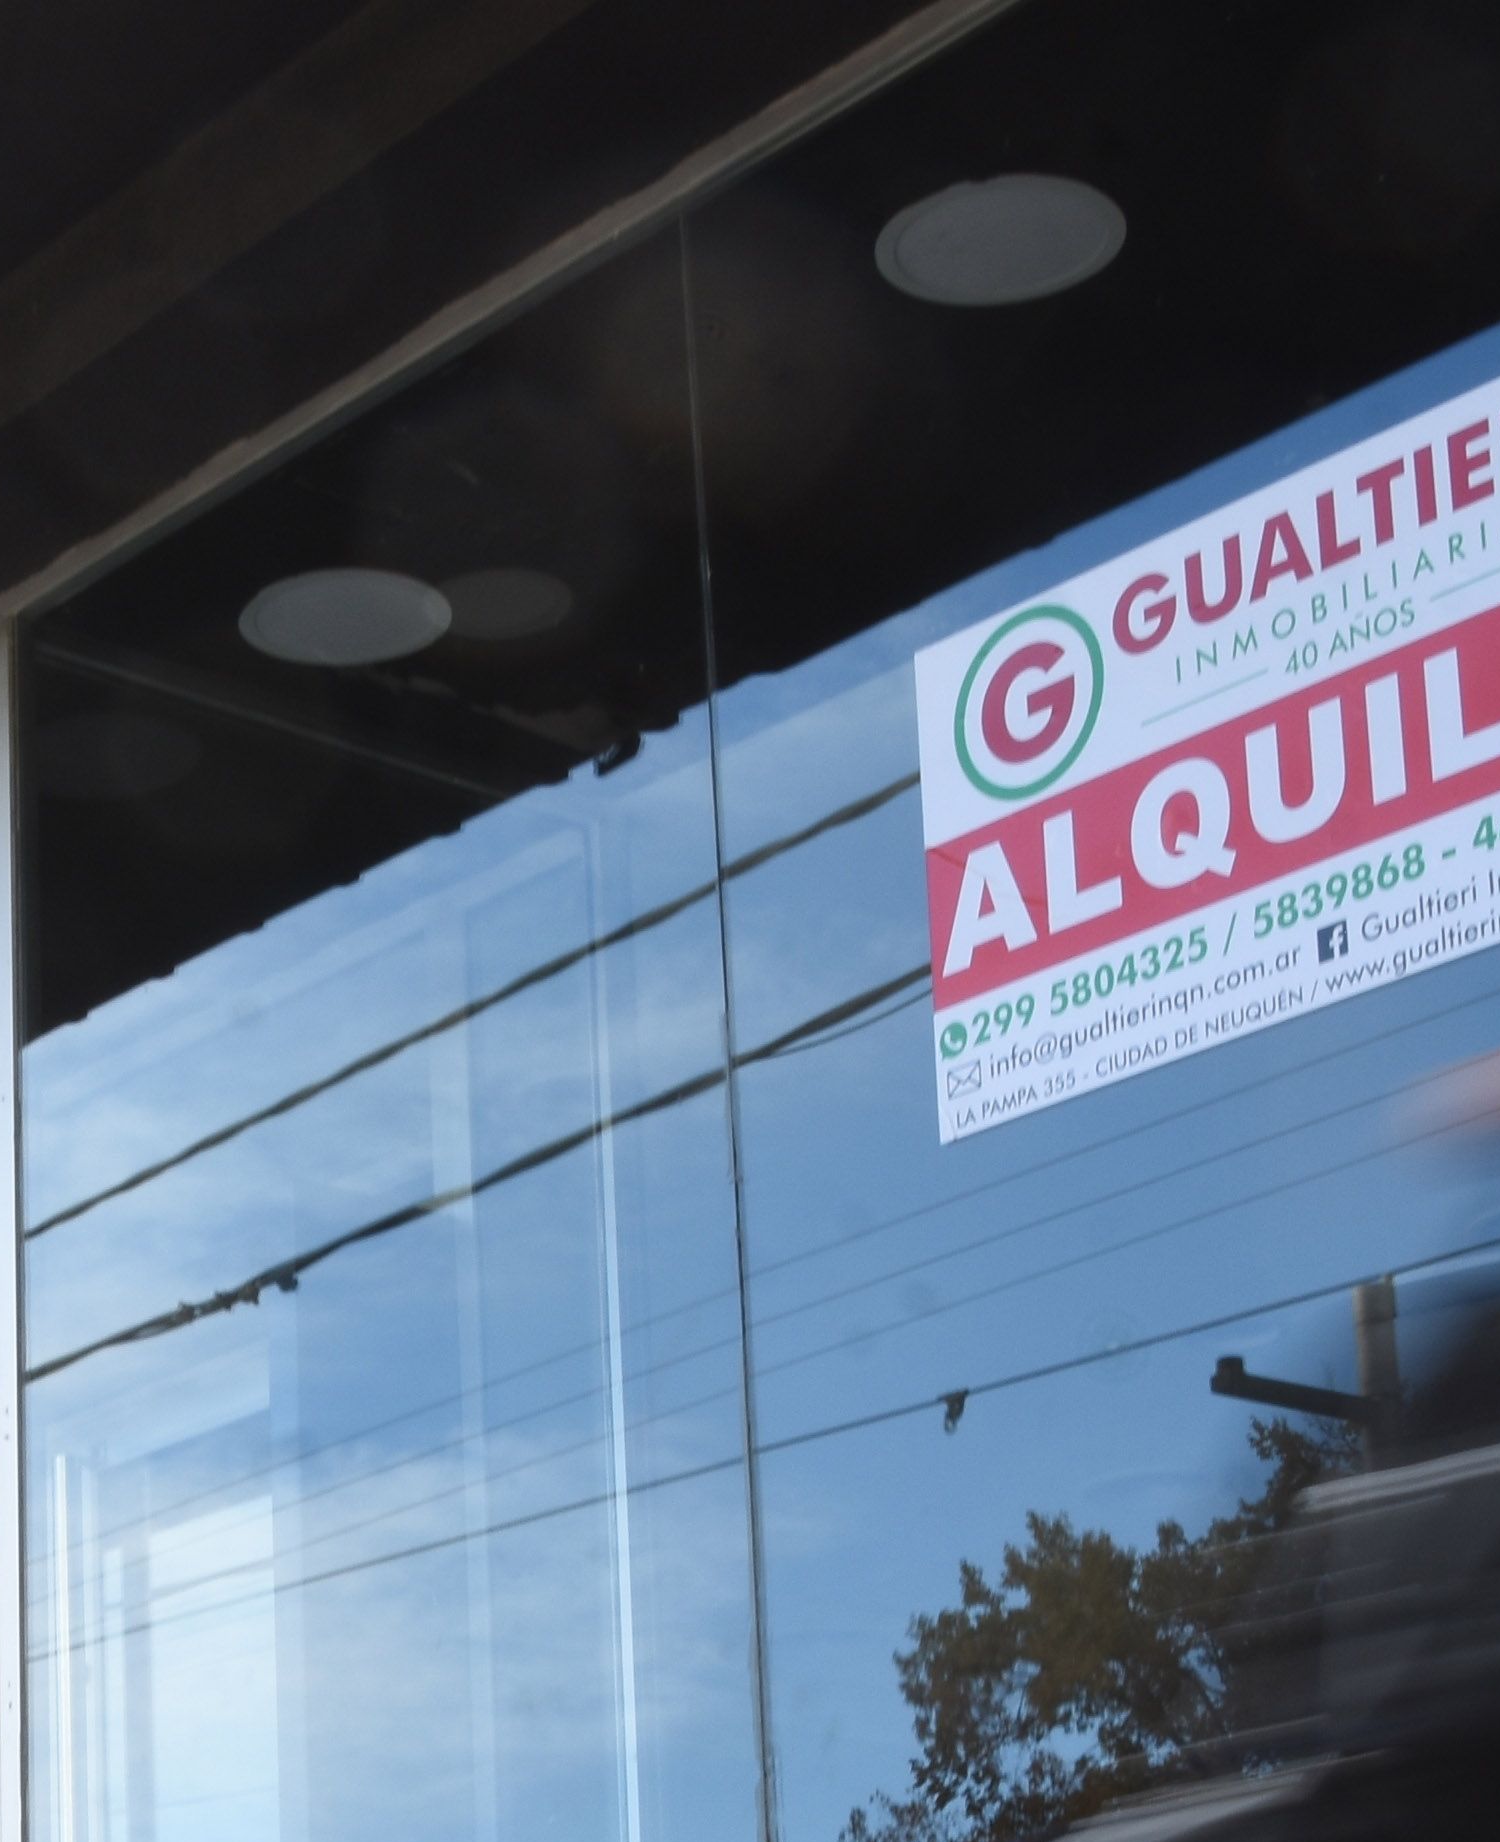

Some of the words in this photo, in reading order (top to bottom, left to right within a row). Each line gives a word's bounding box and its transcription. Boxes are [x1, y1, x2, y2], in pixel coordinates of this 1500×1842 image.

[981, 640, 1076, 765] G
[1285, 641, 1318, 675] 40
[1328, 599, 1416, 658] AÑOS
[971, 993, 1036, 1047] 299
[1050, 926, 1207, 1016] 5804325
[1223, 911, 1238, 956] /
[1253, 843, 1426, 939] 5839868
[989, 945, 1301, 1080] info@gualtierinqn.com.ar
[1360, 879, 1478, 942] Gualtieri
[956, 1105, 977, 1130] LA
[981, 1087, 1038, 1122] PAMPA
[1043, 1067, 1077, 1097] 355
[1095, 1038, 1169, 1079] CIUDAD
[1174, 1023, 1198, 1046] DE
[1205, 985, 1304, 1037] NEUQUÉN
